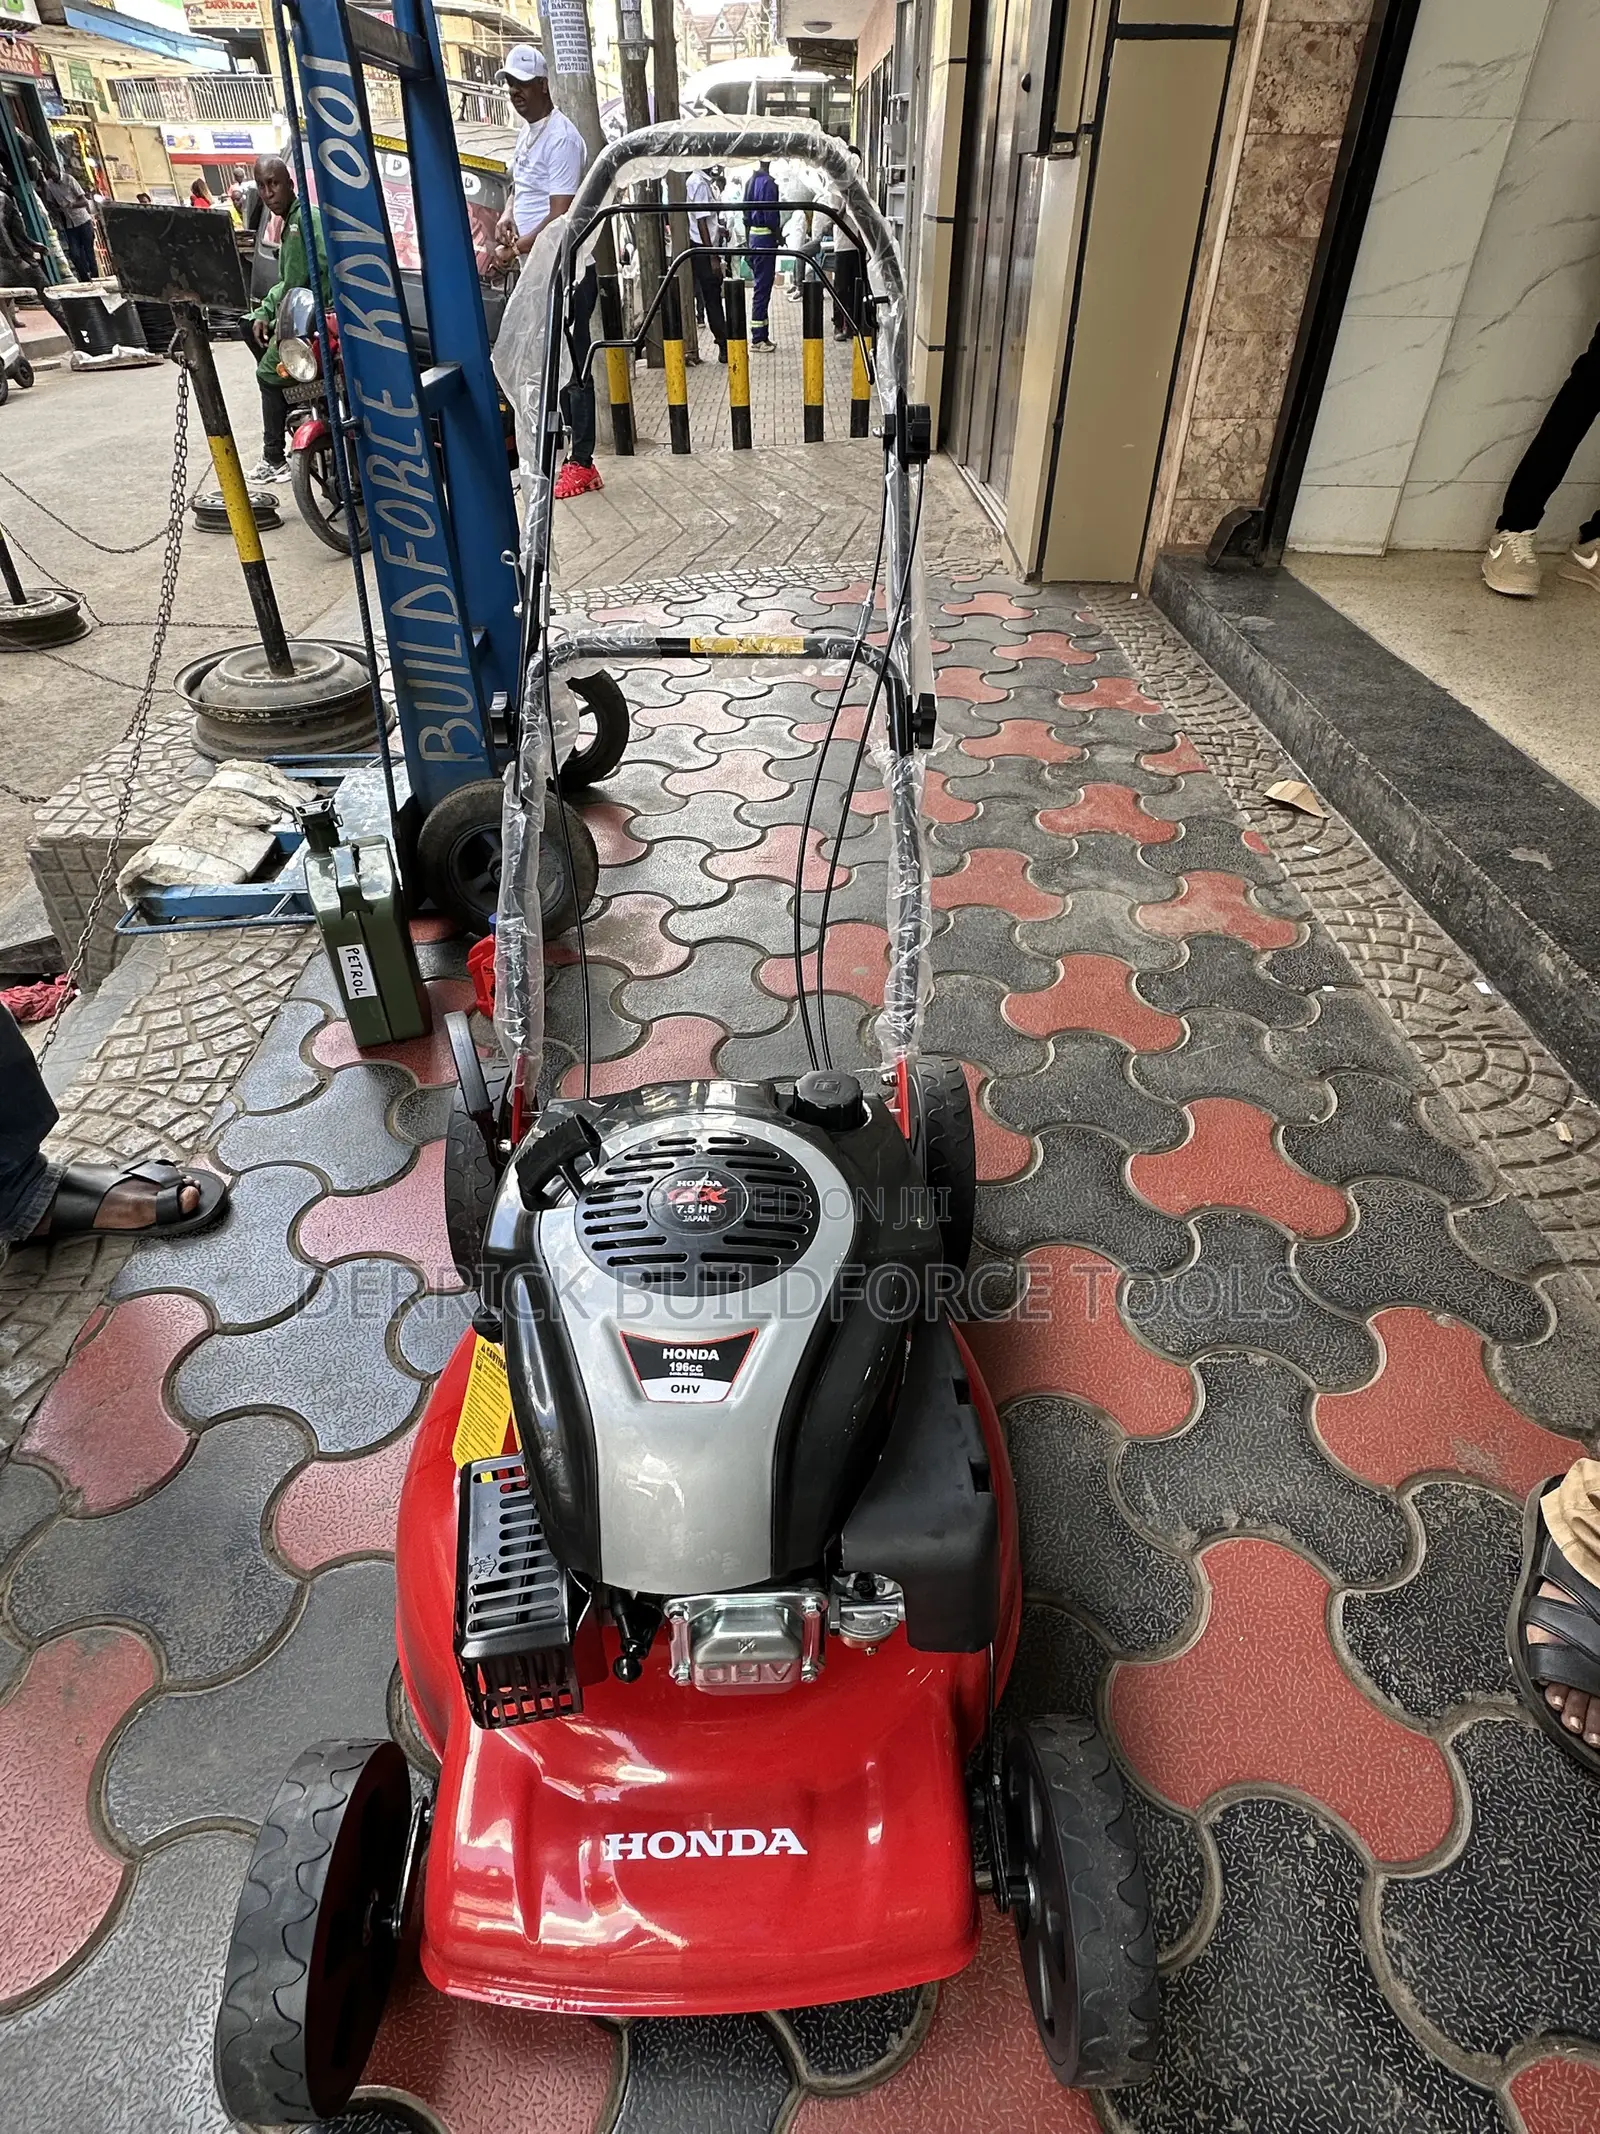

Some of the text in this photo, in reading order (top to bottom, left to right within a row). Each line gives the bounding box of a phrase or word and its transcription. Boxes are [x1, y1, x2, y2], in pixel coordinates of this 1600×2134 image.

[323, 203, 408, 354] KDV
[345, 947, 367, 996] PETROL
[676, 1204, 717, 1214] 7.5 HP
[662, 1348, 720, 1361] HONDA
[669, 1361, 703, 1373] 196cc
[670, 1384, 701, 1394] OHV
[701, 1663, 793, 1684] OHV
[604, 1828, 808, 1861] HONDA
